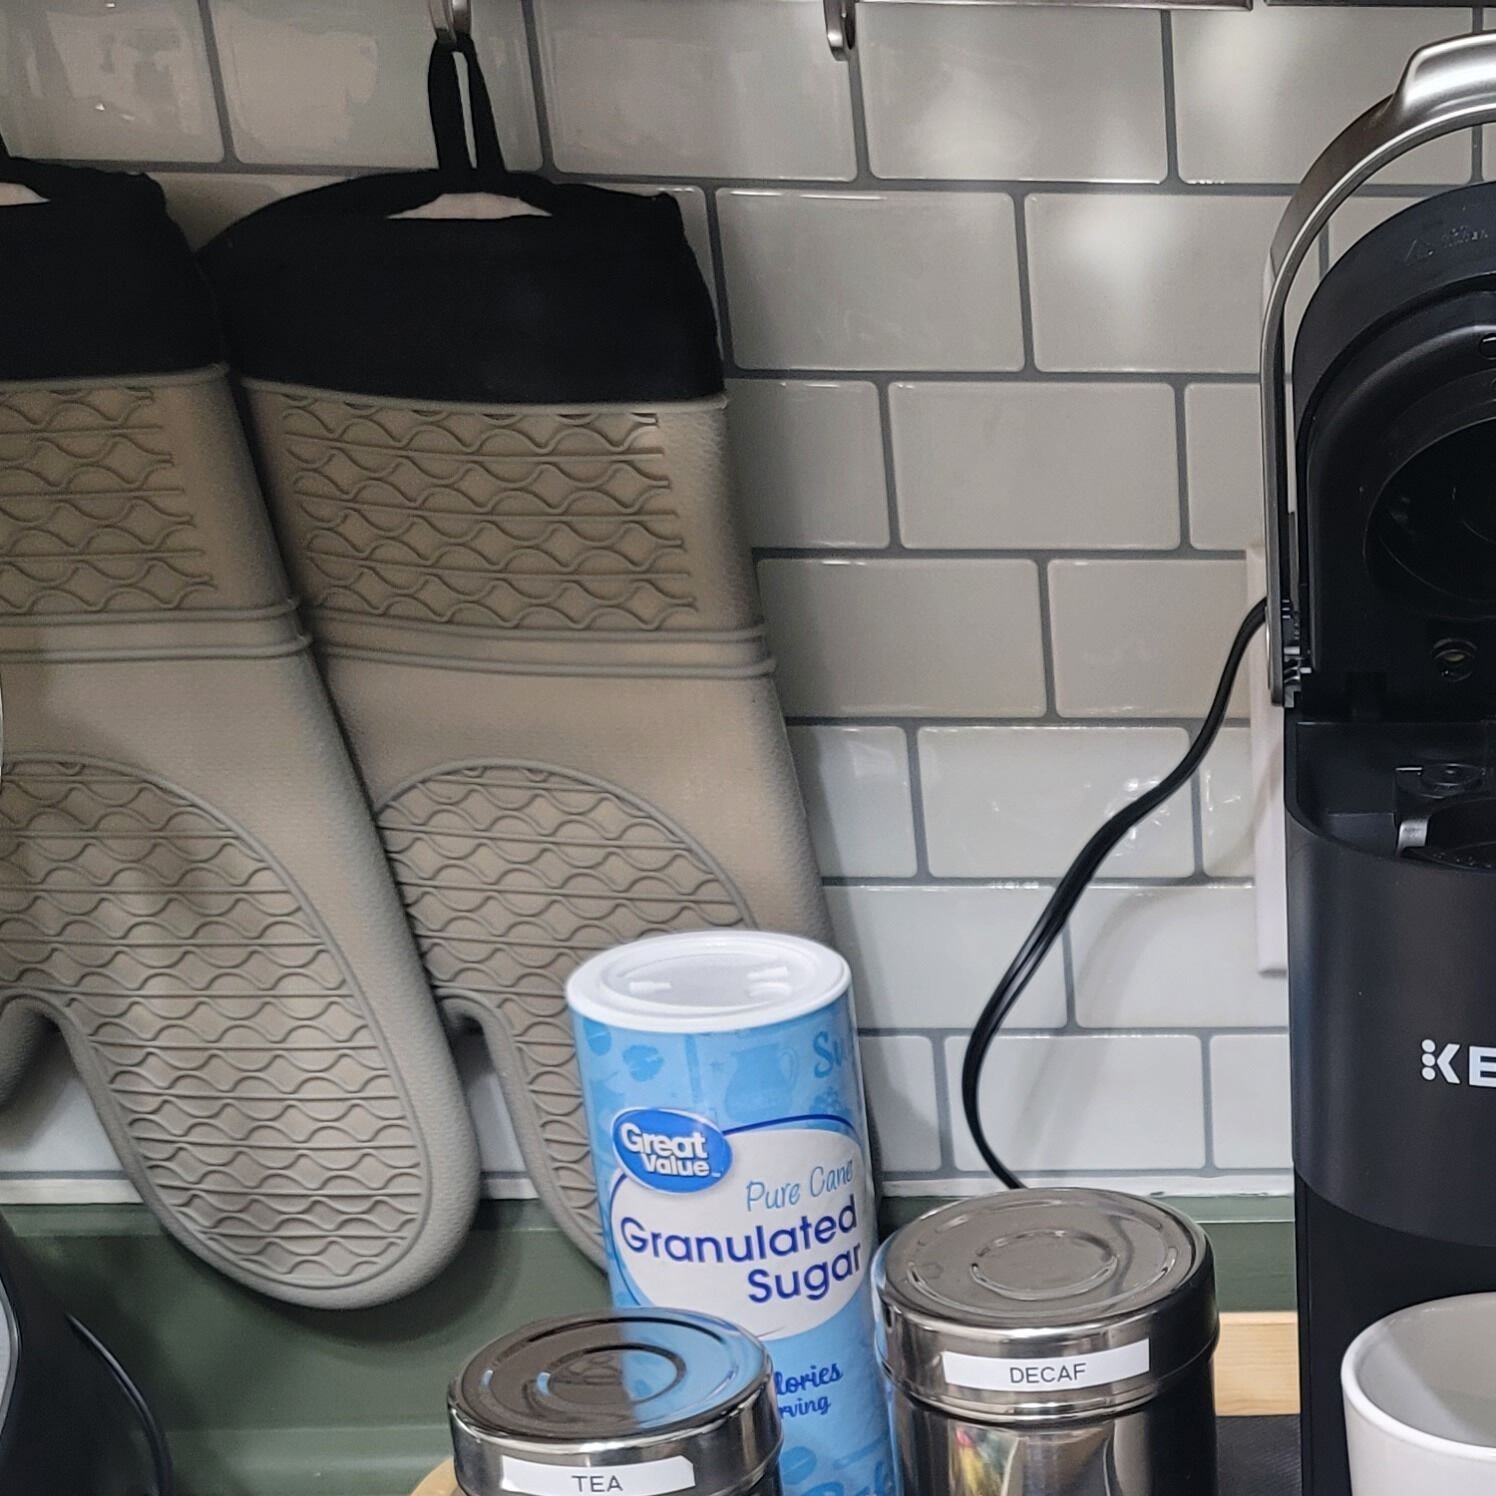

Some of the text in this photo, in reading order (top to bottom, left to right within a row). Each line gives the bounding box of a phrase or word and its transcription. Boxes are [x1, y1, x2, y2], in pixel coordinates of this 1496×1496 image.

[620, 1122, 707, 1159] Great
[640, 1151, 710, 1178] Value
[747, 1160, 853, 1212] Pure Cane
[620, 1194, 858, 1263] Granulated
[747, 1242, 861, 1303] Sugar
[774, 1362, 843, 1396] lories
[1009, 1362, 1086, 1384] DECAF
[571, 1475, 623, 1493] TEA
